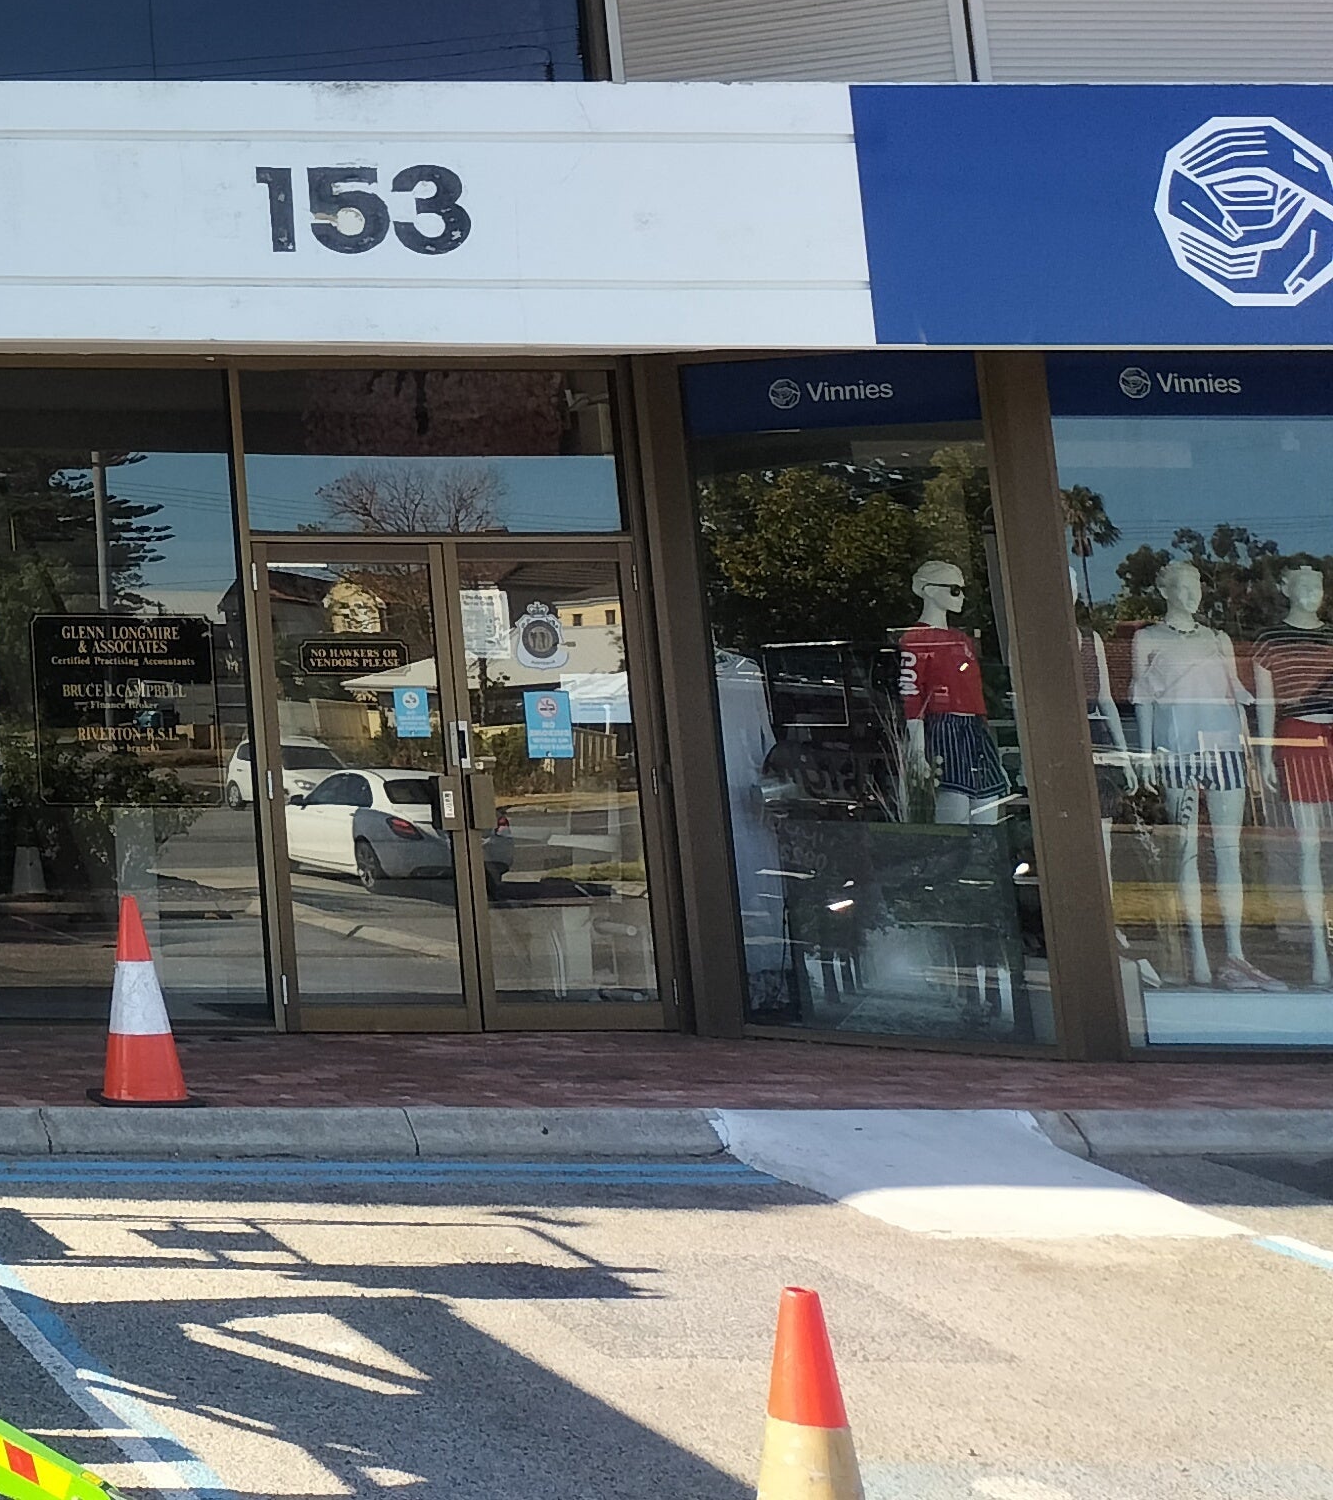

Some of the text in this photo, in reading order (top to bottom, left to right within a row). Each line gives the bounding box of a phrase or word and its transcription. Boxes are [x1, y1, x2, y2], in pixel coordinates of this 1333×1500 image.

[256, 164, 471, 255] 153
[806, 379, 894, 402] Vinnies
[1156, 372, 1242, 395] Vinnies
[61, 625, 180, 640] GLENN LONGMIRE
[78, 640, 168, 654] & ASSOCIATES
[310, 648, 398, 658] NO HAWKERS OR
[51, 656, 196, 667] Certified Practising Accountants
[309, 658, 401, 667] VENDORS PLEASE
[62, 683, 102, 697] BRUCE
[77, 727, 142, 741] RIVERTON
